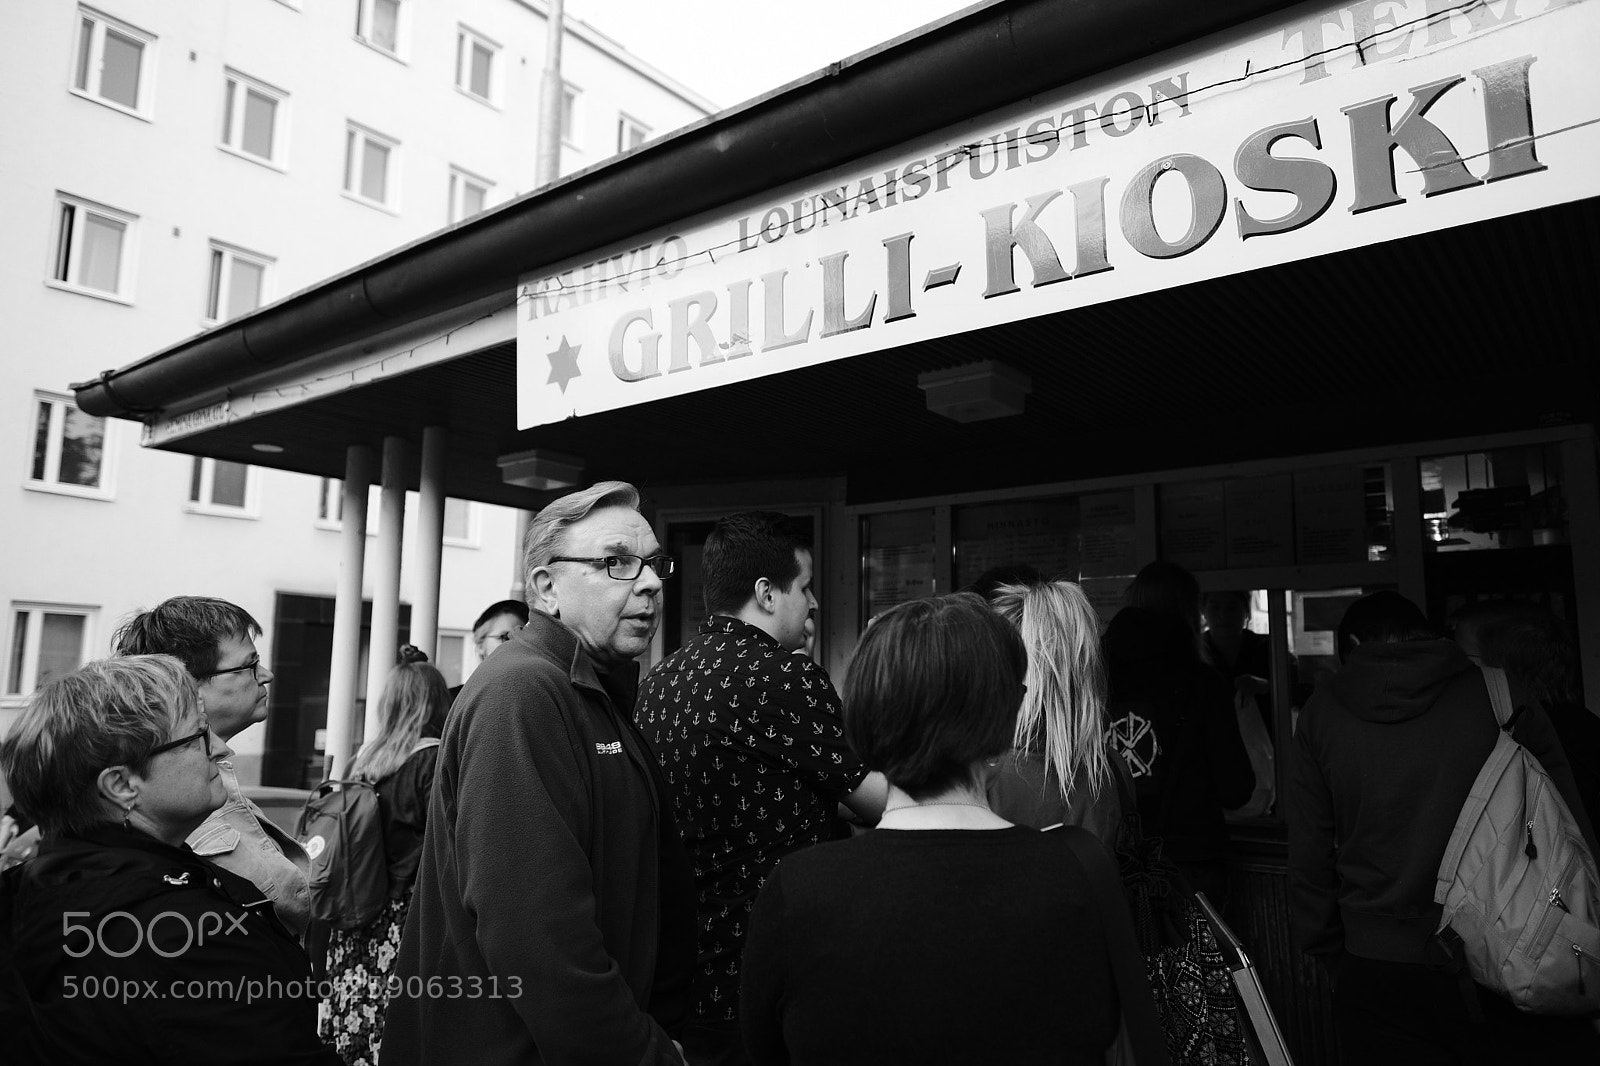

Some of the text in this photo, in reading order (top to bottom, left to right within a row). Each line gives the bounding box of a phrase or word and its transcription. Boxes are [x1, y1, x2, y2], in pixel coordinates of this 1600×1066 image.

[527, 0, 1589, 321] KAHVIO LOUNAISPUISTON TER
[607, 55, 1549, 383] GRILLI-KIOSKI
